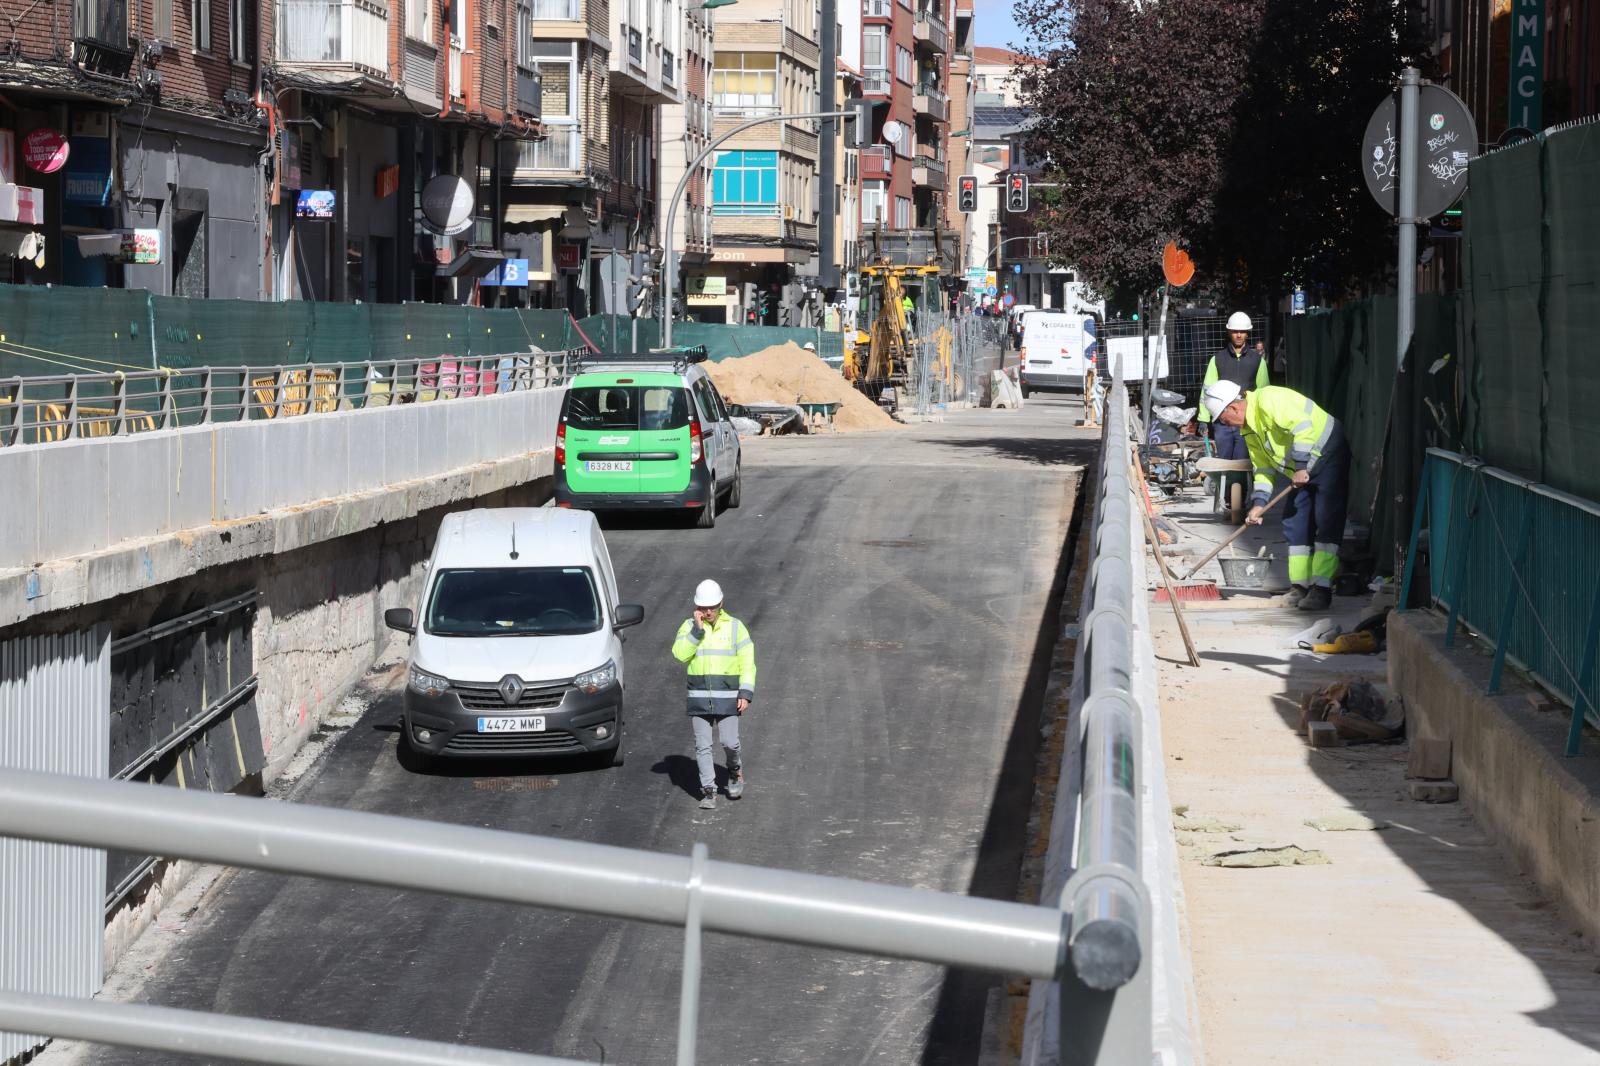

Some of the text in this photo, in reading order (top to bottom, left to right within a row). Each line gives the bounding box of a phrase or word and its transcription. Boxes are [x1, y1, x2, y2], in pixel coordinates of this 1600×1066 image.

[1518, 0, 1537, 128] MACI
[590, 461, 631, 471] 6328 KLZ
[486, 718, 542, 731] 4472 MMP
